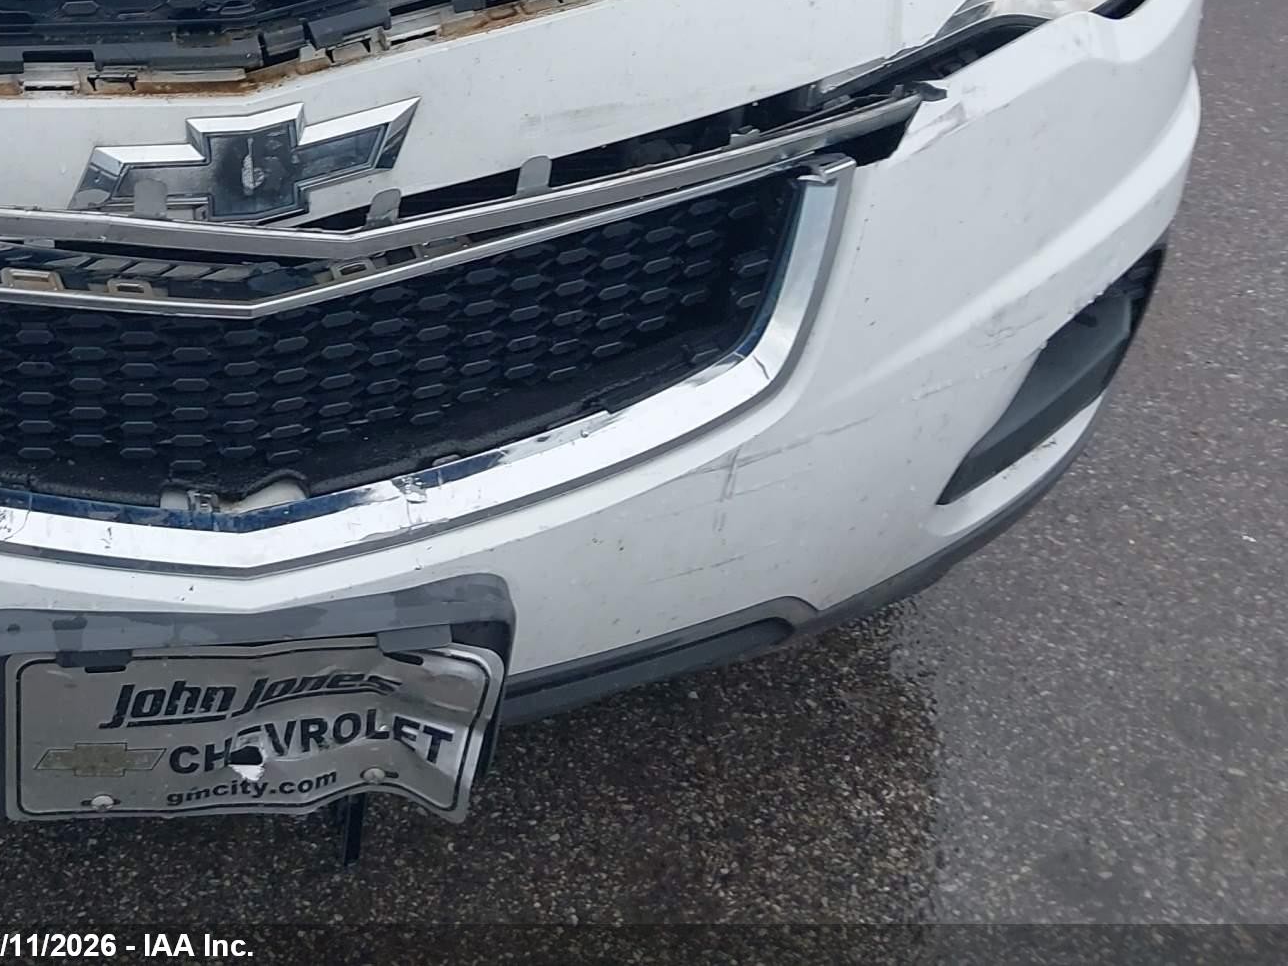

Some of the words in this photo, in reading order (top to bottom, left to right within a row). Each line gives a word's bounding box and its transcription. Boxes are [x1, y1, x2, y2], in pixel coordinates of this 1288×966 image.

[99, 680, 236, 729] John
[231, 672, 403, 718] Jones
[166, 771, 337, 806] gmcity.com
